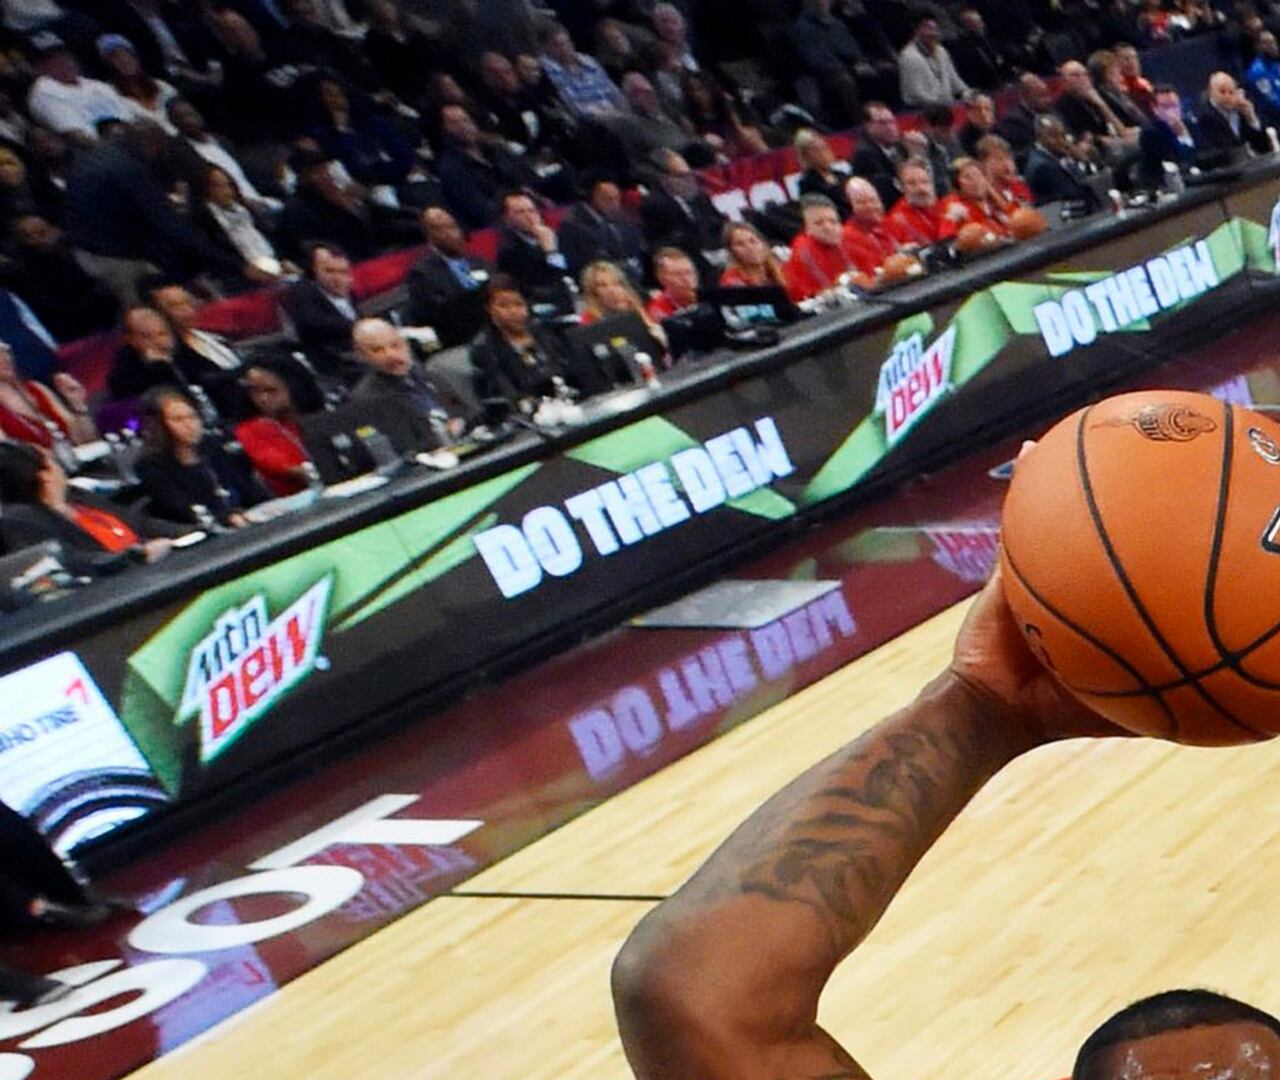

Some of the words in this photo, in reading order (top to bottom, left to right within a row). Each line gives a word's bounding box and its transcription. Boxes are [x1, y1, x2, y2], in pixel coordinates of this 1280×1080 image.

[1033, 282, 1095, 357] DO
[1086, 261, 1154, 336] THE
[1147, 239, 1222, 302] DEW
[473, 505, 583, 600] DO
[564, 463, 686, 556] THE
[671, 416, 796, 514] DEW
